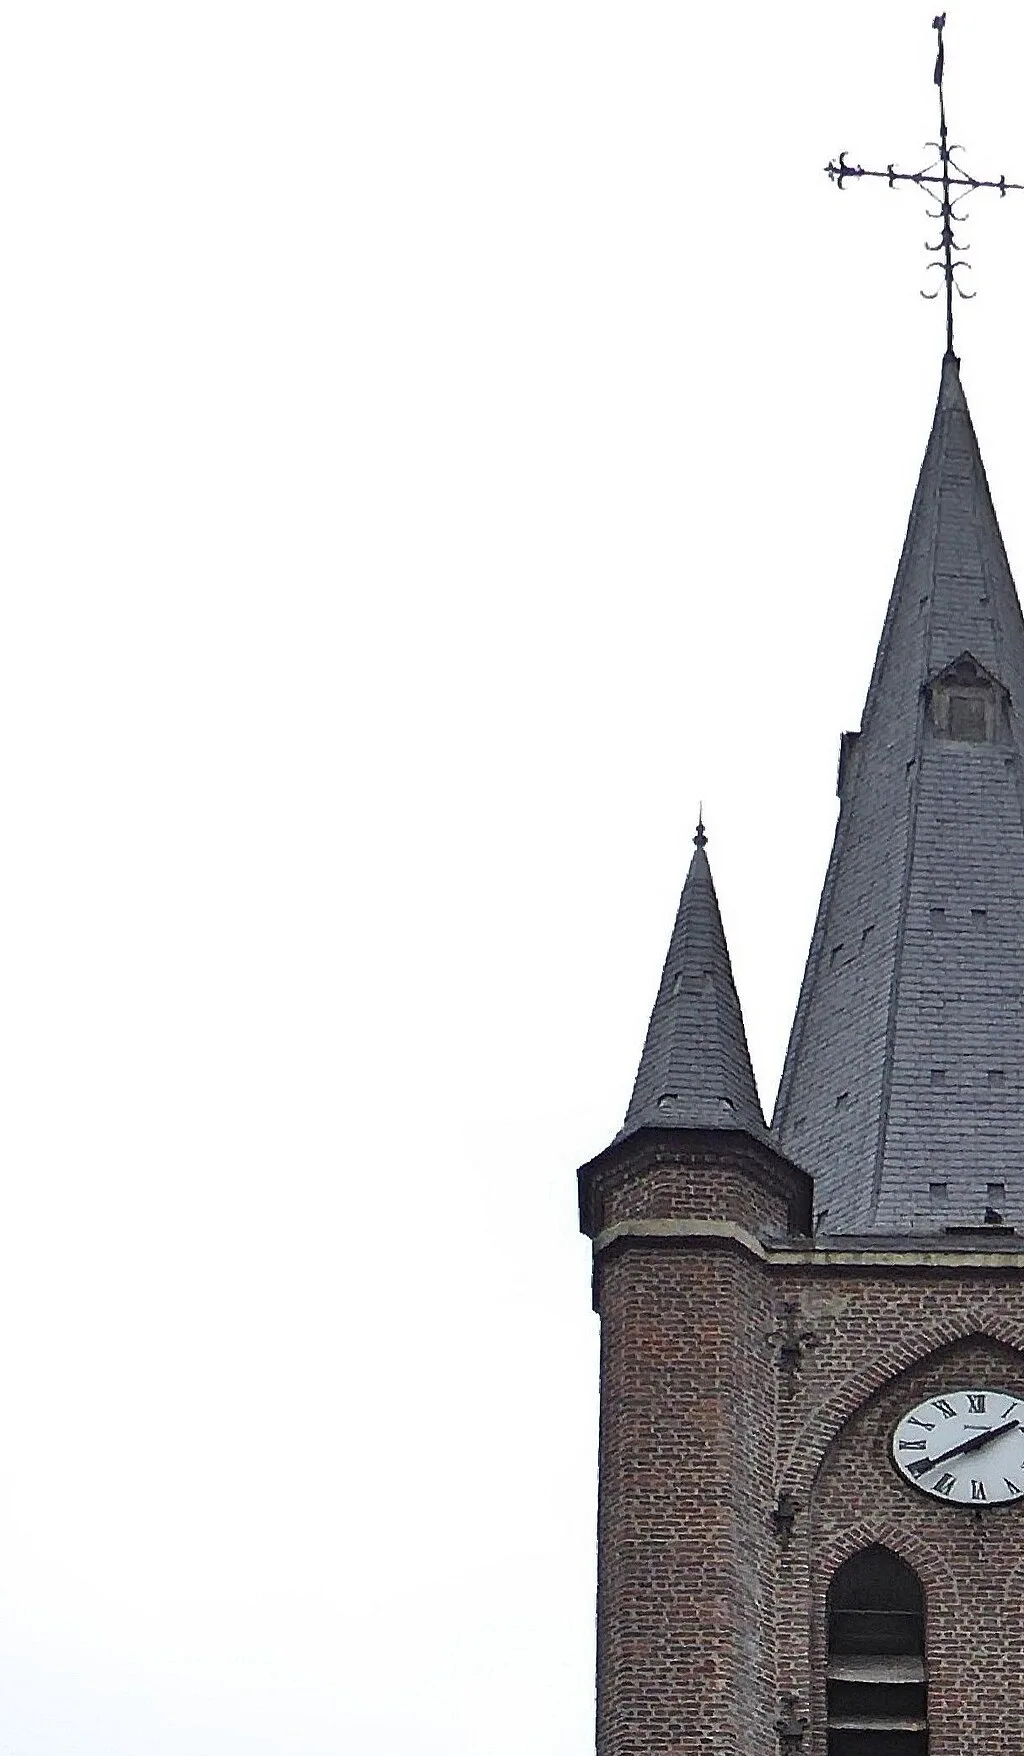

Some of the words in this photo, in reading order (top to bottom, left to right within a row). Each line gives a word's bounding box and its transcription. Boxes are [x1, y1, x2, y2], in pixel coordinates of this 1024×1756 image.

[931, 1399, 957, 1419] XI
[966, 1394, 986, 1414] XII
[1001, 1402, 1018, 1418] I
[907, 1416, 935, 1431] X
[898, 1439, 927, 1450] IX
[970, 1479, 987, 1500] VI
[1002, 1477, 1021, 1494] V
